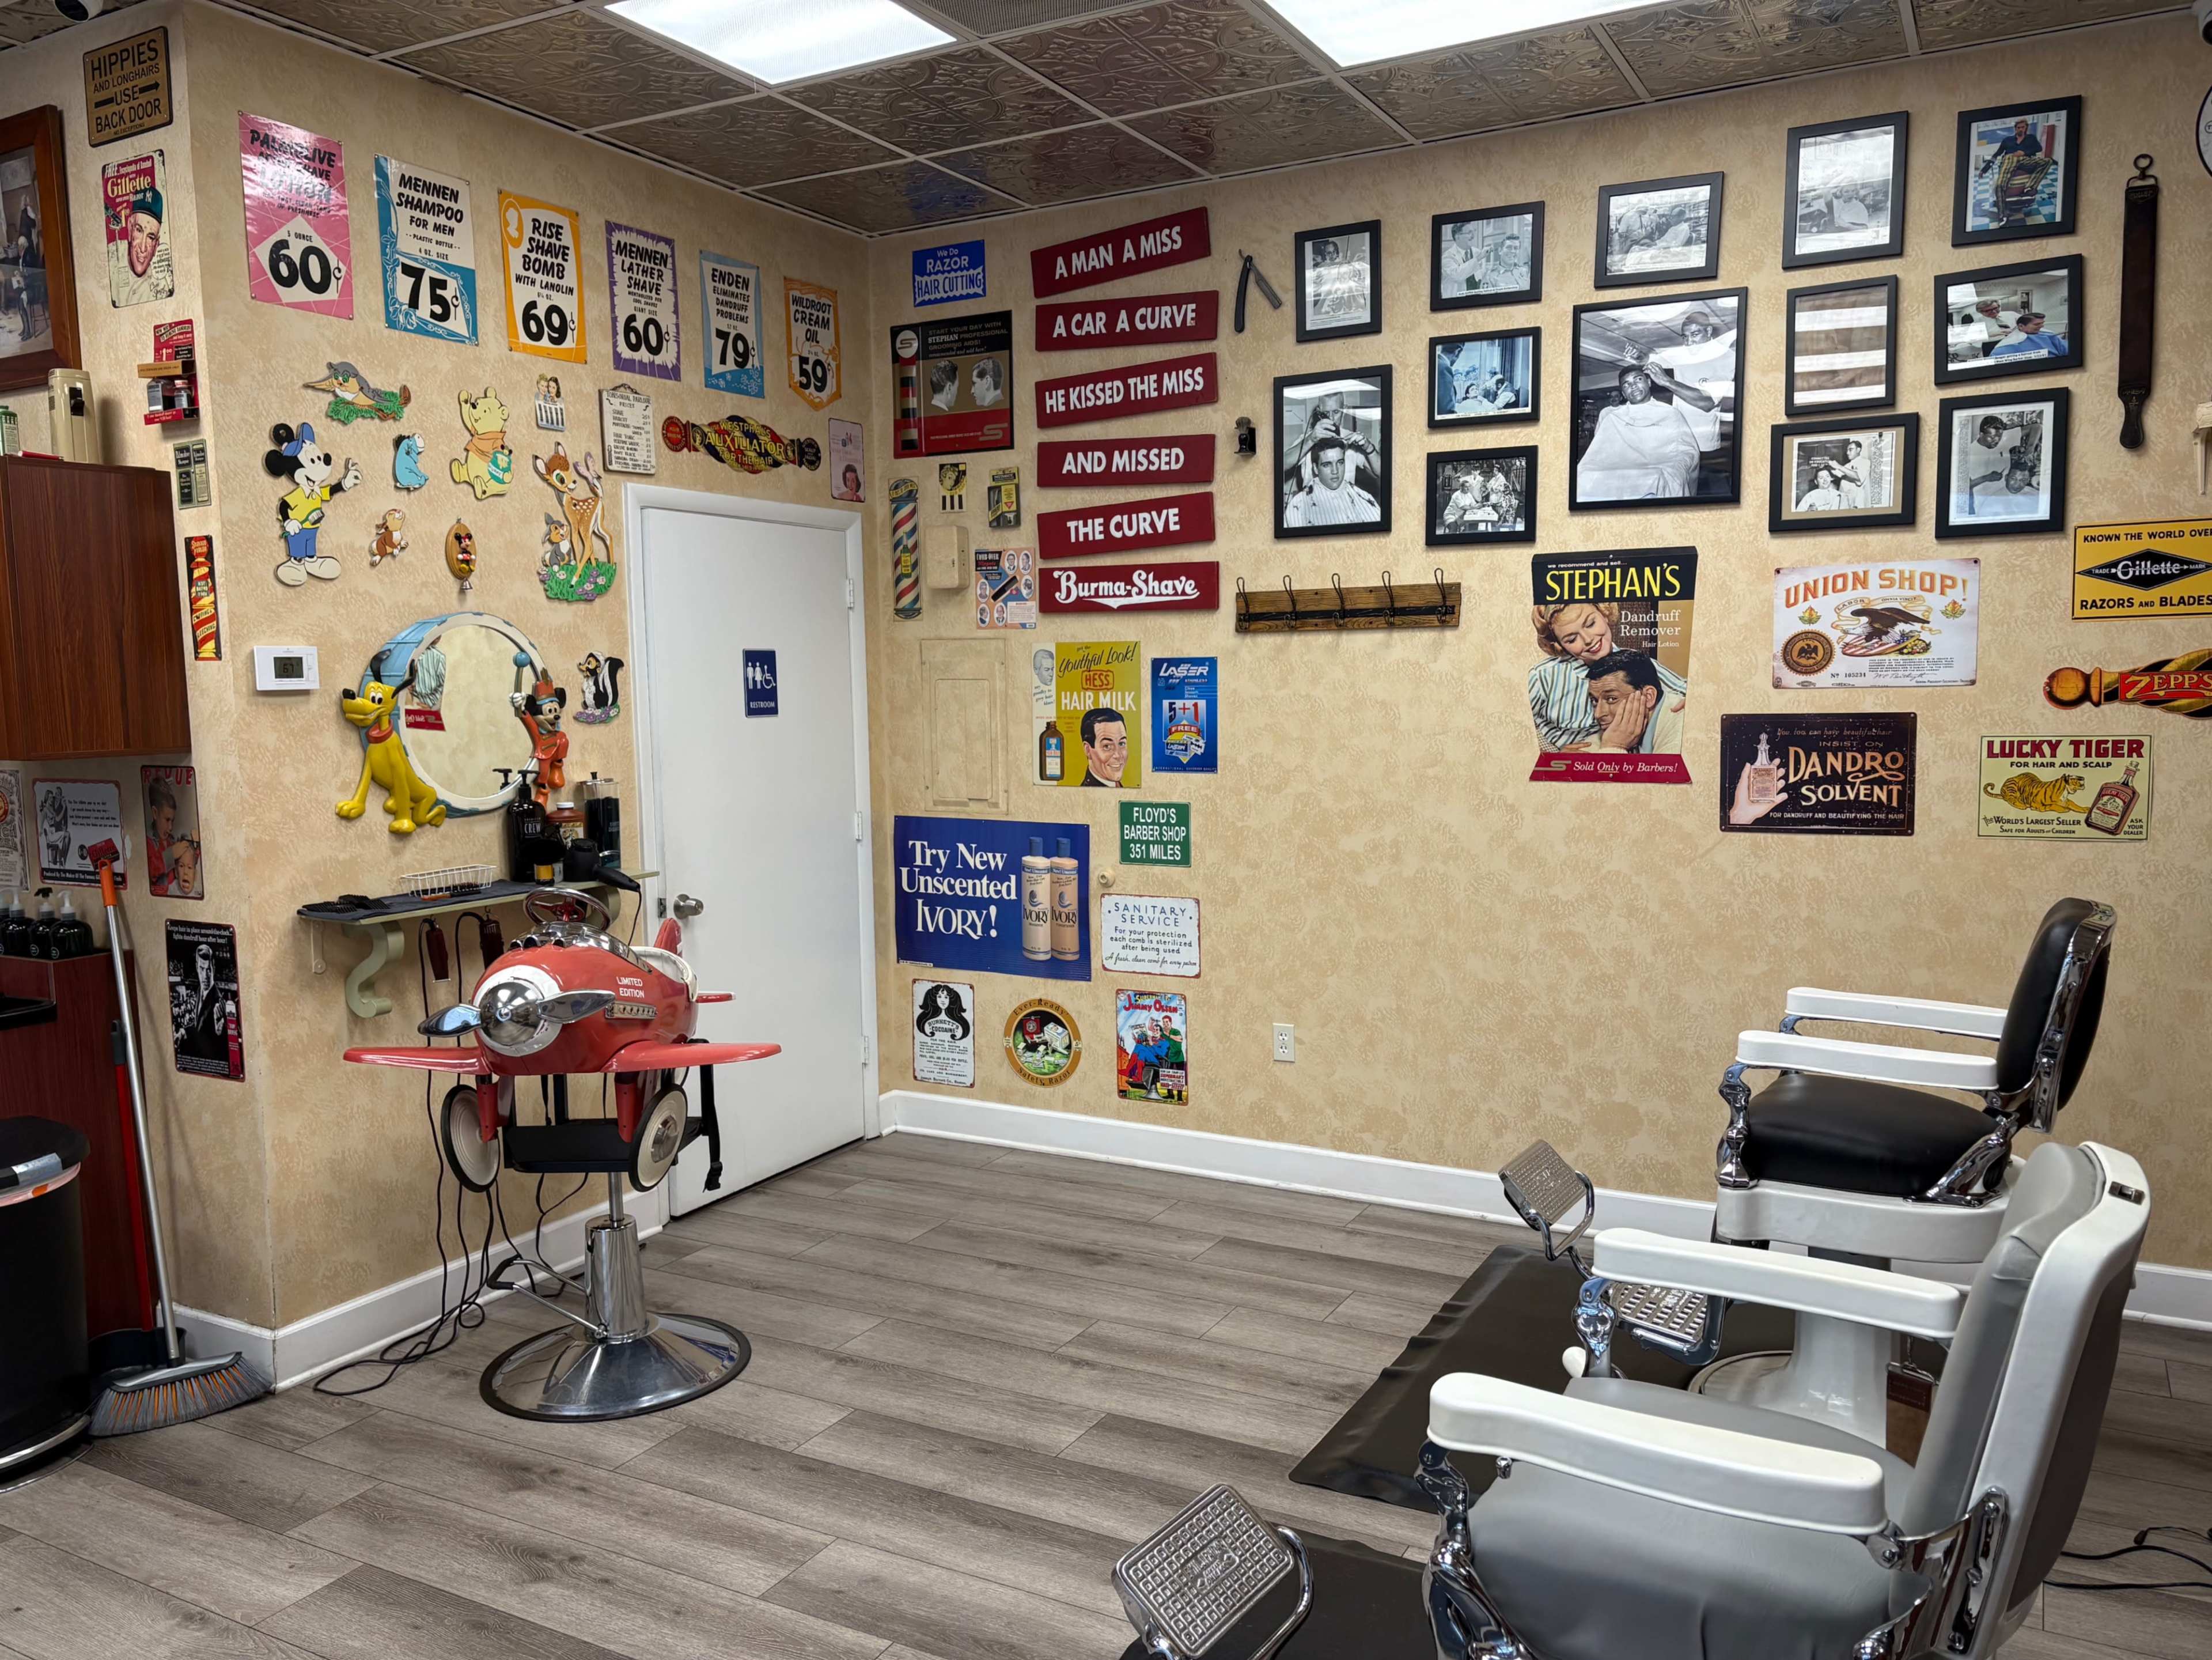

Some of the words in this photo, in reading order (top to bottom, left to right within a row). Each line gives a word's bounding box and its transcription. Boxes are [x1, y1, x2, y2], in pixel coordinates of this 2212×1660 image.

[91, 39, 158, 81] HIPPIES
[93, 80, 109, 93] AND
[112, 63, 160, 87] LONGHAIRS
[115, 85, 139, 105] USE
[96, 108, 126, 133] BACK
[129, 98, 161, 123] DOOR
[120, 123, 145, 134] EXCEPTIONS
[107, 174, 151, 198] Gillette
[399, 173, 459, 204] MENNEN
[396, 192, 464, 224] SHAMPOO
[410, 215, 429, 230] FOR
[433, 223, 455, 237] MEN
[531, 218, 564, 241] RISE
[527, 236, 570, 262] SHAVE
[615, 240, 668, 269] MENNEN
[937, 248, 948, 256] We
[949, 247, 959, 256] Do
[1055, 256, 1067, 280] A
[1071, 243, 1113, 275] MAN
[1122, 239, 1137, 263] A
[1140, 226, 1182, 259] MISS
[268, 239, 342, 294] 60¢
[522, 254, 566, 280] BOMB
[621, 260, 664, 282] LATHER
[926, 255, 969, 274] RAZOR
[515, 273, 536, 287] WITH
[540, 279, 574, 296] LANOLIN
[627, 276, 662, 296] SHAVE
[711, 268, 750, 292] ENDEN
[916, 280, 940, 299] HAIR
[942, 271, 982, 294] CUTTING
[401, 262, 460, 323] 75¢
[713, 285, 751, 303] ELIMINATES
[715, 297, 748, 313] DANDRUFF
[791, 294, 832, 315] WILDROOT
[522, 300, 576, 346] 69¢
[716, 308, 749, 324] PROBLEMS
[793, 309, 830, 331] CREAM
[1052, 315, 1067, 338] A
[1071, 312, 1107, 336] CAR
[1115, 309, 1130, 332] A
[1135, 303, 1196, 331] CURVE
[623, 313, 671, 356] 60¢
[805, 327, 820, 344] OIL
[928, 328, 949, 336] START
[949, 326, 968, 334] YOUR
[984, 322, 1002, 330] WITH
[928, 333, 959, 344] STEPHAN
[960, 329, 1009, 341] PROFESSIONAL
[715, 327, 756, 369] 79¢
[1045, 390, 1066, 414] HE
[1069, 380, 1124, 410] KISSED
[1127, 373, 1158, 400] THE
[1162, 366, 1204, 396] MISS
[719, 421, 771, 440] WESTPHAL'S
[704, 430, 786, 461] AUXILIATOR
[719, 448, 736, 461] FOR
[738, 454, 754, 464] THE
[753, 455, 773, 466] HAIR
[1062, 451, 1107, 474] AND
[1111, 447, 1184, 472] MISSED
[1066, 517, 1104, 543] THE
[1109, 508, 1180, 539] CURVE
[2083, 533, 2121, 543] KNOWN
[2124, 532, 2143, 541] THE
[2147, 530, 2185, 540] WORLD
[2116, 561, 2181, 580] Gillette
[1053, 569, 1200, 604] Burma-Shave
[1546, 562, 1681, 602] STEPHAN'S
[1783, 569, 1870, 609] UNION
[1878, 568, 1968, 602] SHOP!
[2080, 598, 2134, 610] RAZORS
[2160, 595, 2212, 607] BLADES
[1620, 609, 1681, 623] Dandruff
[1620, 625, 1681, 637] Remover
[1058, 651, 1103, 678] Youthful
[1105, 641, 1138, 665] Look!
[1159, 663, 1209, 676] LASER
[1085, 672, 1111, 689] HESS
[2125, 674, 2212, 699] ZEPP'S
[1061, 691, 1094, 711] HAIR
[1099, 691, 1137, 711] MILK
[1987, 740, 2065, 758] LUCKY
[2069, 739, 2144, 758] TIGER
[1573, 761, 1594, 772] Sold
[1597, 761, 1619, 774] Only
[1622, 762, 1634, 773] by
[1637, 762, 1678, 773] Barbers!
[1788, 746, 1906, 784] DANDRO
[143, 767, 193, 787] REVUE
[1801, 784, 1902, 807] SOLVENT
[1133, 807, 1176, 823] FLOYD'S
[1994, 816, 2024, 825] WORLD'S
[524, 823, 541, 834] CREW
[1124, 825, 1160, 841] BARBER
[1162, 826, 1187, 842] SHOP
[908, 840, 950, 874] Try
[956, 843, 1007, 871] New
[1130, 844, 1146, 859] 351
[1150, 845, 1181, 860] MILES
[899, 867, 1017, 900] Unscented
[916, 899, 997, 940] IVORY!
[1023, 905, 1049, 924] IVORY
[1051, 906, 1077, 924] IVORY
[1114, 902, 1187, 917] SANITARY
[1122, 914, 1180, 927] SERVICE
[1115, 927, 1125, 935] For
[1128, 929, 1144, 937] your
[1147, 929, 1187, 939] protection
[1156, 937, 1192, 947] sterilized
[1141, 946, 1160, 955] being
[616, 976, 643, 987] LIMITED
[619, 988, 645, 999] EDITION
[1049, 1069, 1070, 1084] Razor
